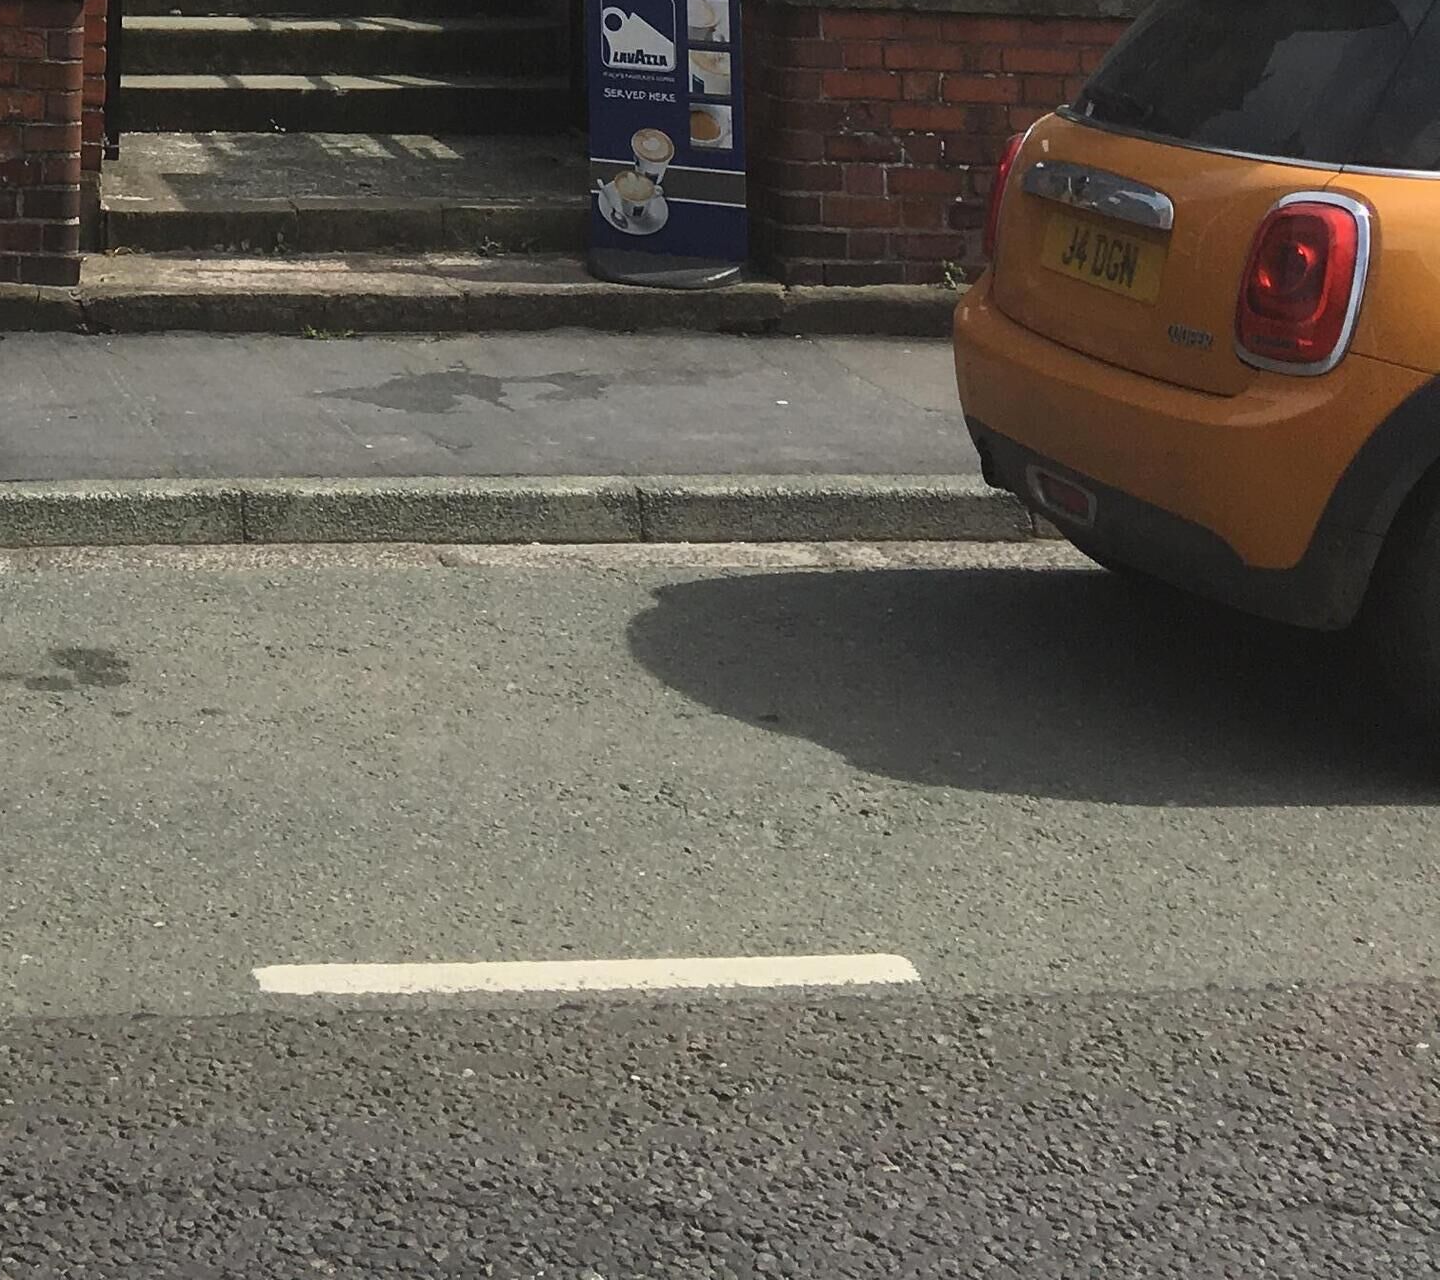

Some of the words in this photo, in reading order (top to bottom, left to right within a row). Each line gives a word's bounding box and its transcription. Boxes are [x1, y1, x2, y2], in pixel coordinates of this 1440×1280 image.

[613, 49, 668, 67] LAVAZZA
[604, 87, 646, 100] SERVED
[648, 92, 677, 103] HERE
